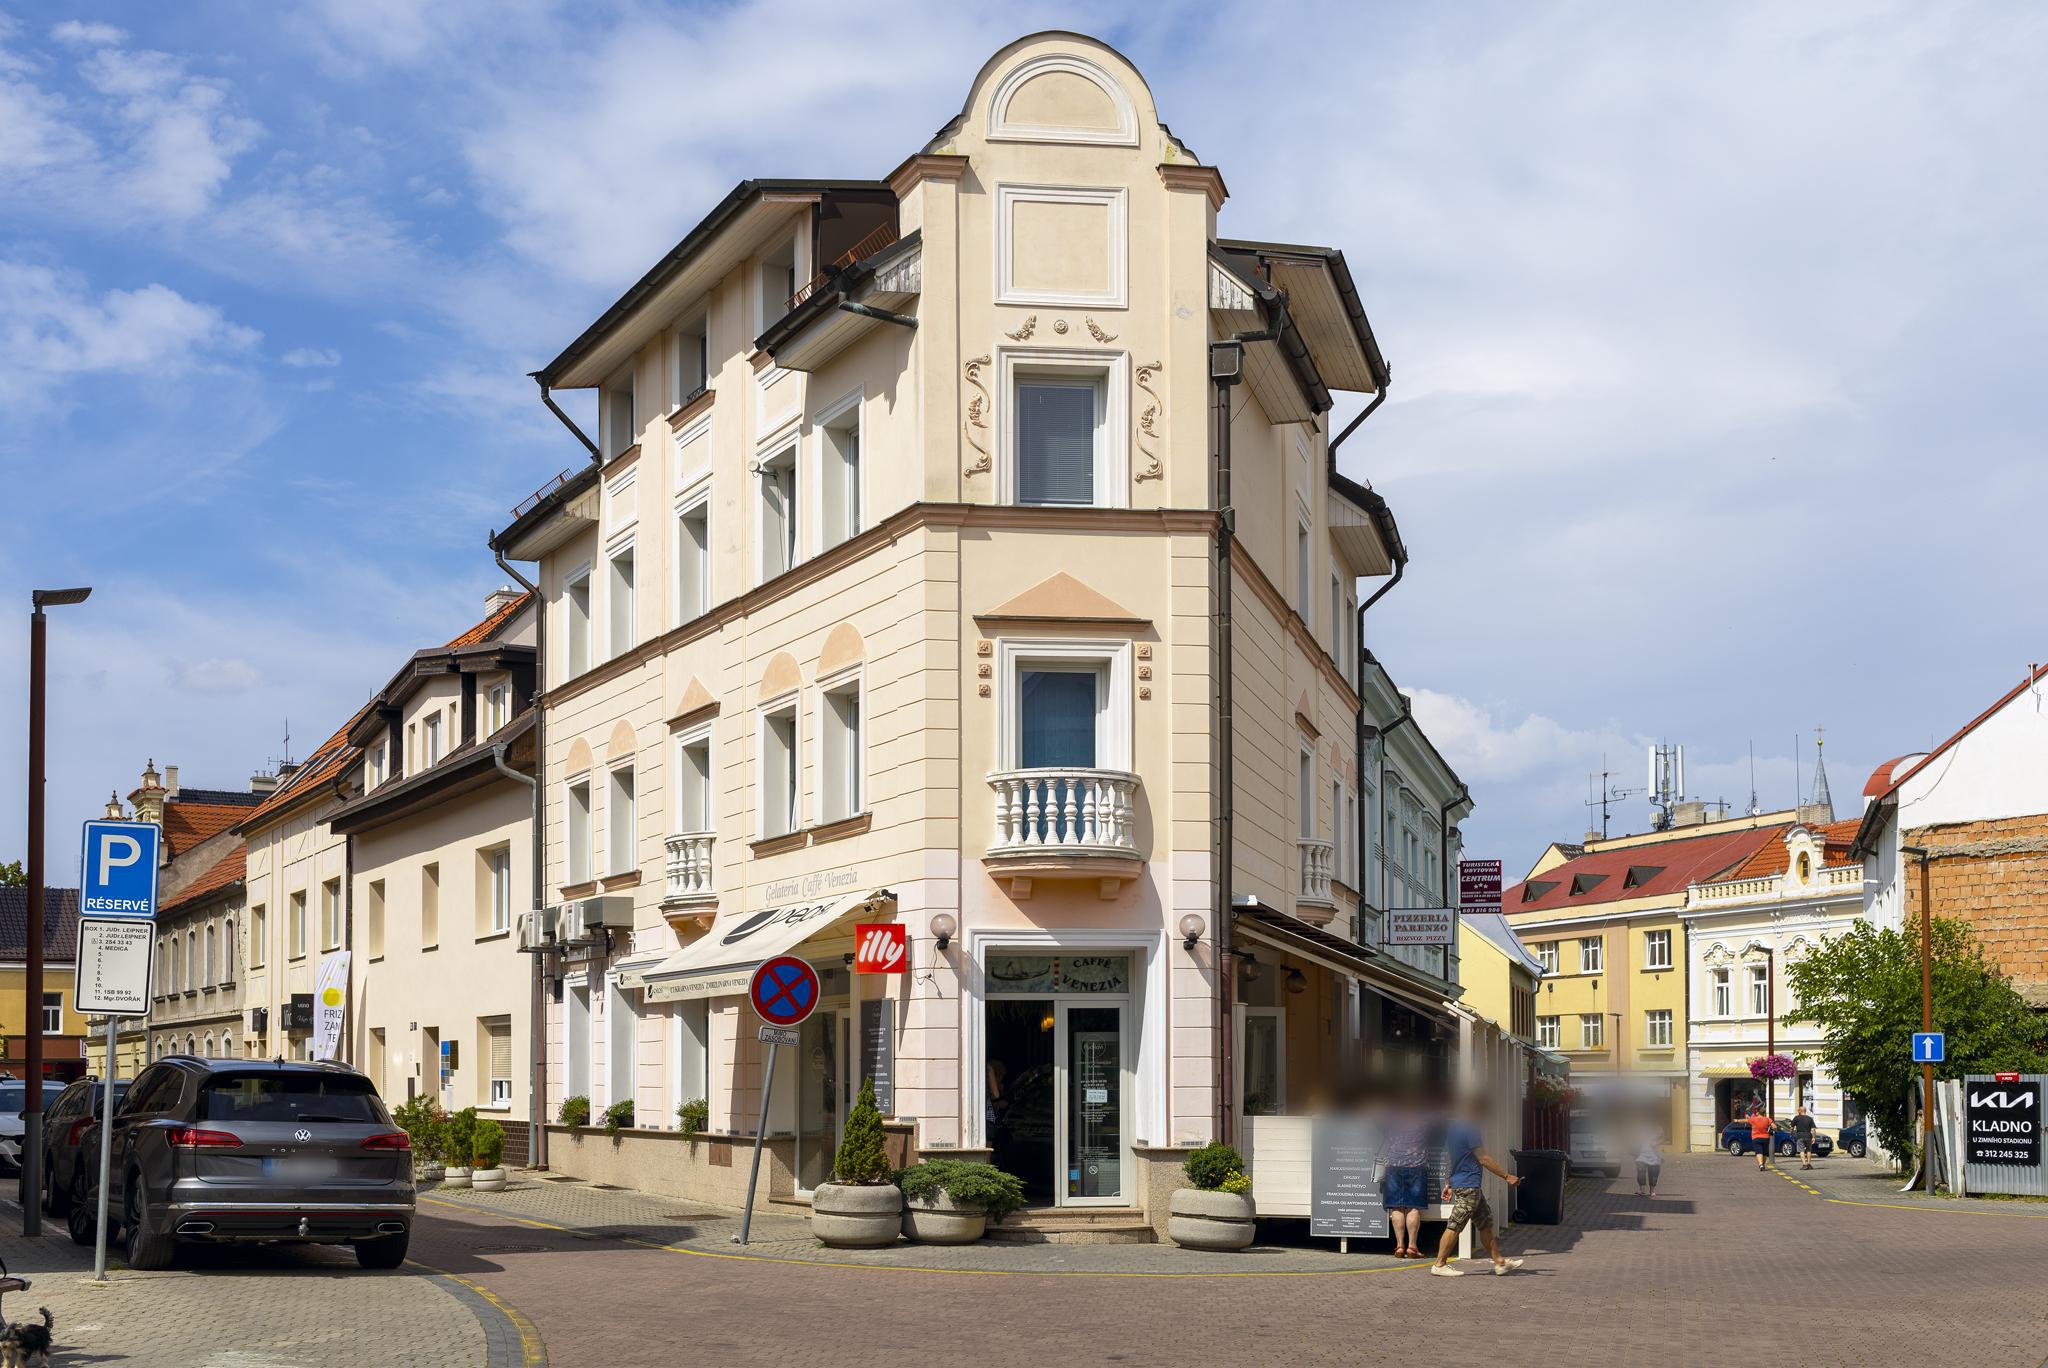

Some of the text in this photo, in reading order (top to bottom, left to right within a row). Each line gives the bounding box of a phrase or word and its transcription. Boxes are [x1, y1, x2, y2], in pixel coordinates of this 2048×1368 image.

[99, 834, 141, 886] P
[765, 882, 799, 907] Gelateria
[824, 867, 858, 889] Venezia
[87, 896, 149, 911] RÉSERVÉ
[1393, 915, 1449, 923] PIZZERIA
[1395, 924, 1448, 932] PARENZO
[858, 929, 905, 970] illy
[1062, 975, 1123, 992] VENEZIA
[324, 1010, 342, 1019] FRIZ
[324, 1022, 340, 1031] ZAN
[328, 1033, 337, 1043] TE
[1972, 1120, 2032, 1133] KLADNO
[1999, 1150, 2013, 1158] 245
[2014, 1151, 2029, 1159] 325
